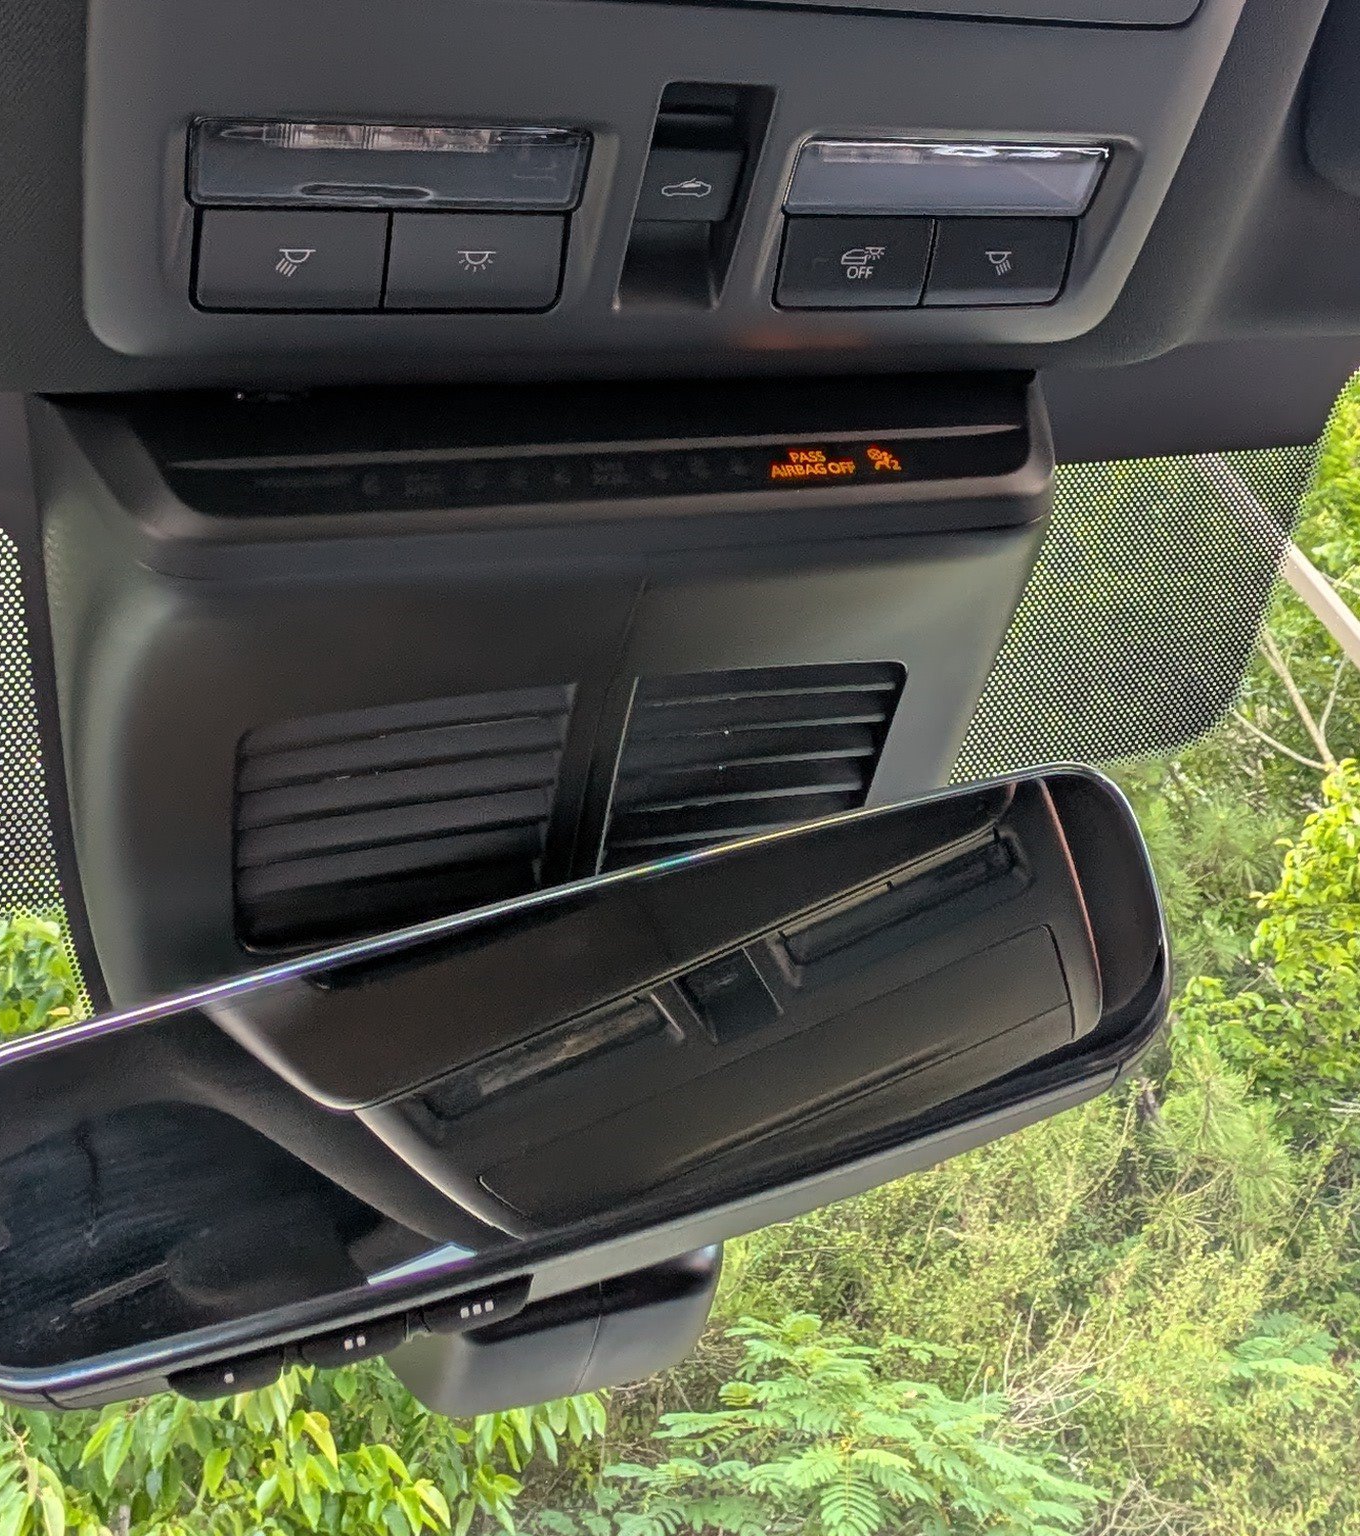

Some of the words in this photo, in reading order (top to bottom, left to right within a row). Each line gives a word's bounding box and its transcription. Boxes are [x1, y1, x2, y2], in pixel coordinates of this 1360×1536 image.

[846, 266, 874, 279] OFF
[789, 450, 827, 463] PASS
[771, 463, 828, 478] AIRBAG
[827, 461, 856, 474] OFF
